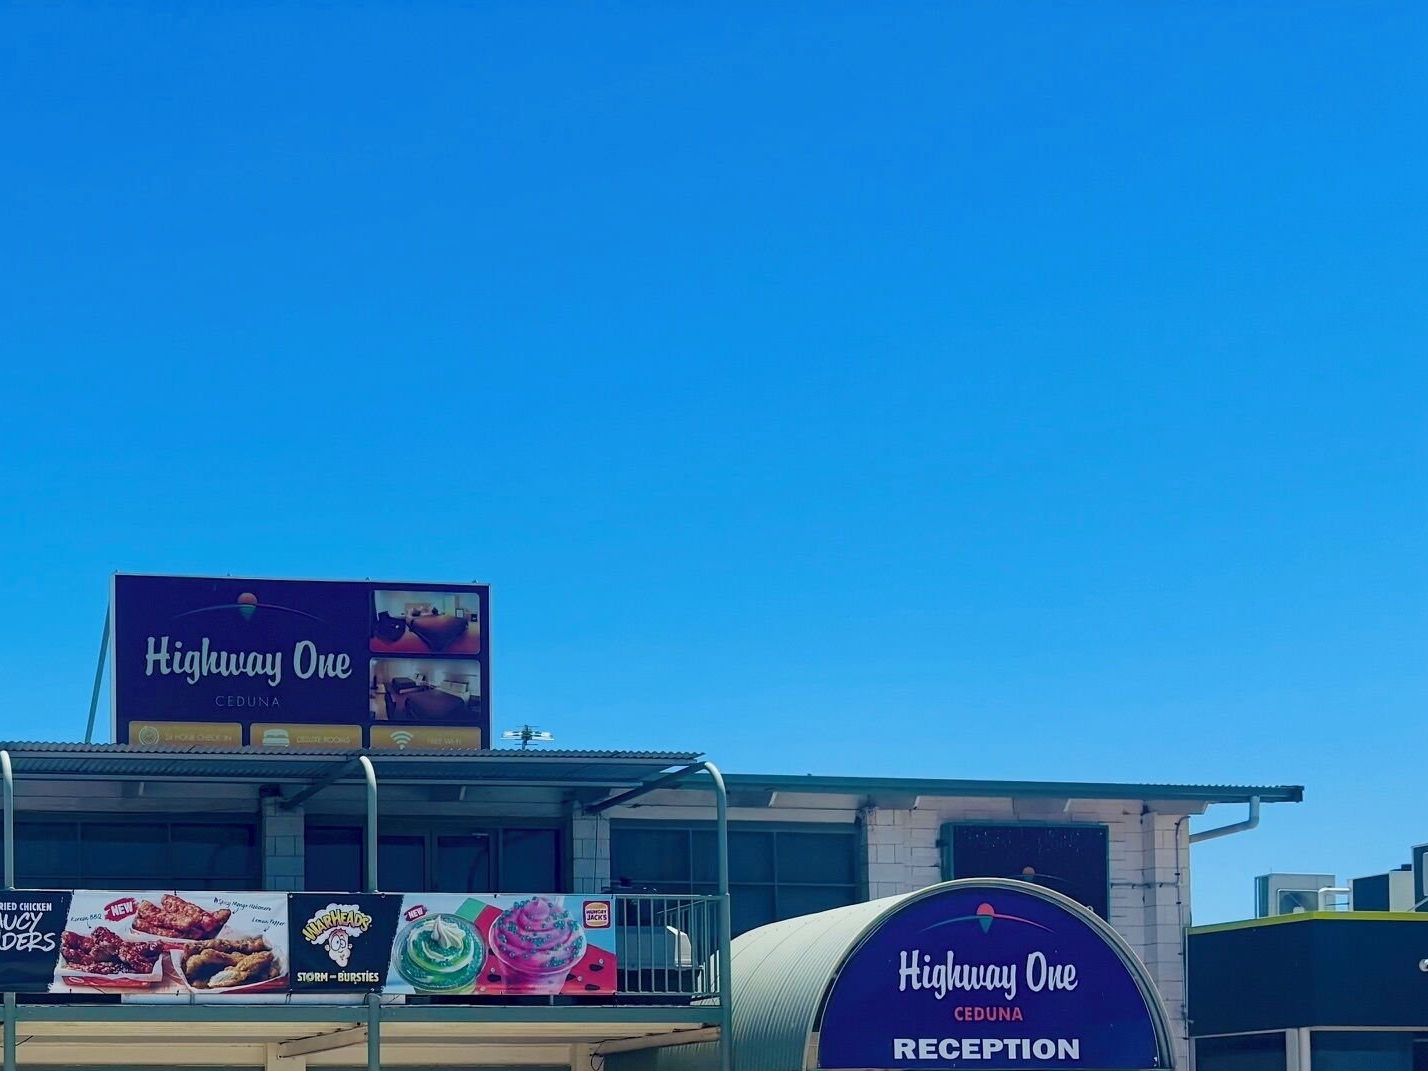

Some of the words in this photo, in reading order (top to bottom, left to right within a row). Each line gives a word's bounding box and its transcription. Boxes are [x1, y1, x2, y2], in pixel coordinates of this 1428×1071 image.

[145, 636, 283, 687] Highway
[293, 640, 352, 679] One
[215, 695, 280, 708] CEDUNA
[19, 902, 52, 911] CHICKEN
[110, 901, 133, 917] NEW
[407, 907, 424, 919] NEW
[302, 909, 371, 941] WARHEADS
[337, 970, 379, 984] BURSTIES
[898, 949, 1017, 1001] Highway
[1025, 951, 1079, 992] One
[954, 1006, 1023, 1022] CEDUNA
[893, 1038, 1080, 1060] RECEPTION
